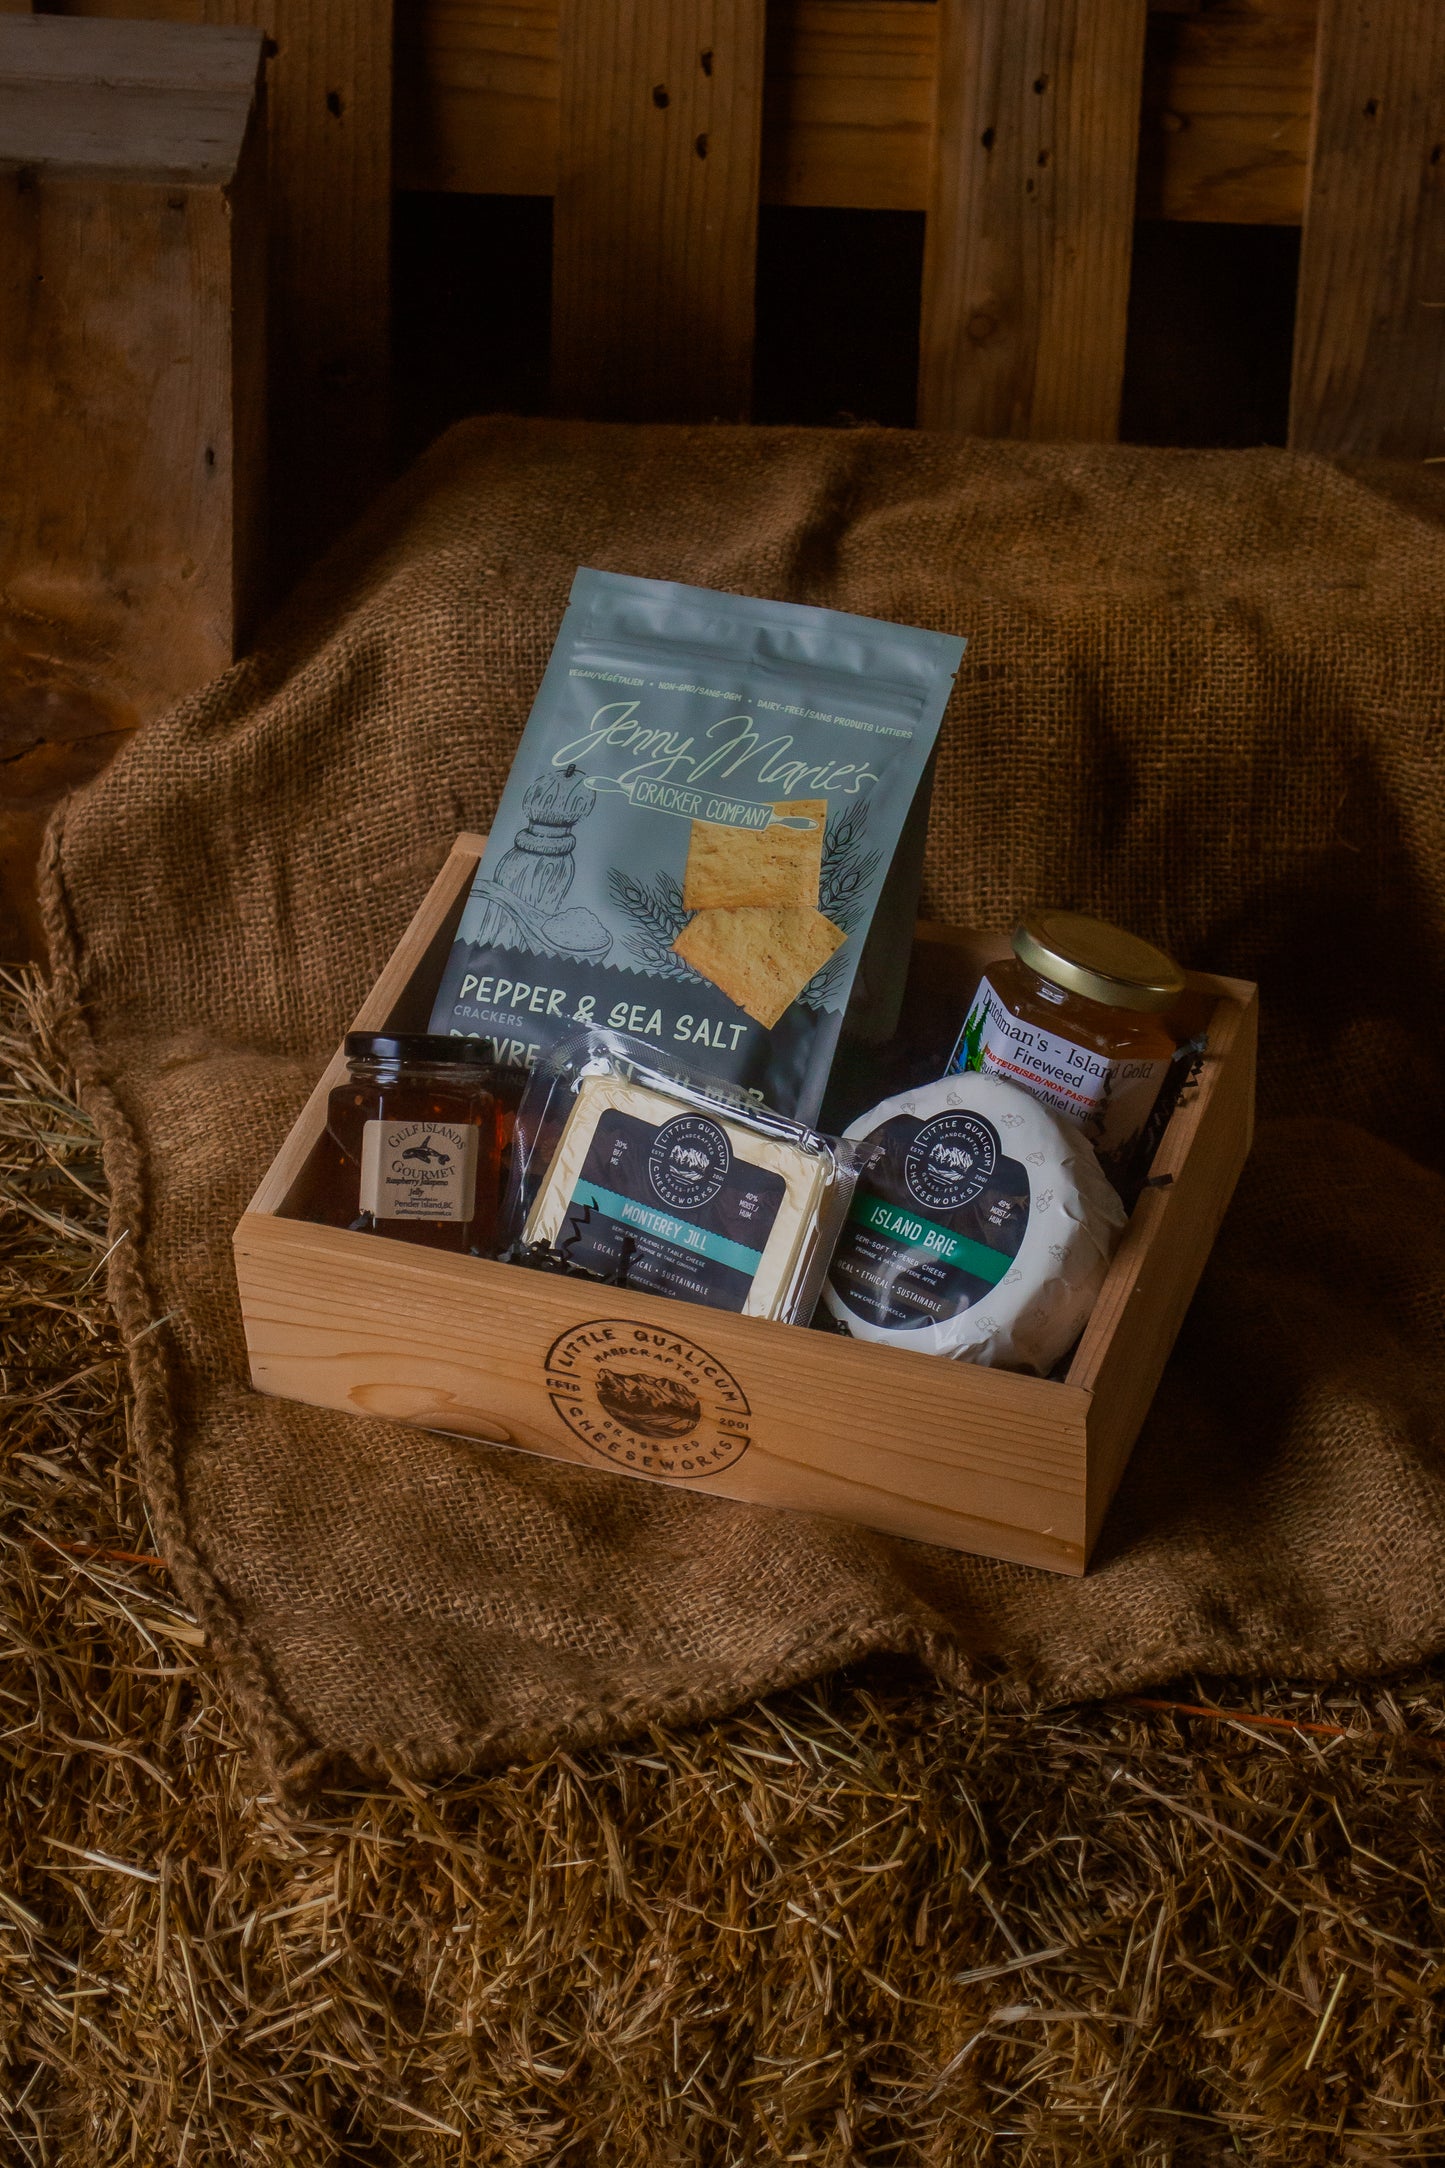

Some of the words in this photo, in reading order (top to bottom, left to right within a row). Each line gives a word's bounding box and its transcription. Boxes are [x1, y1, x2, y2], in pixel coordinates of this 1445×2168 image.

[757, 699, 832, 723] DAIRY-FREE/SANS
[833, 716, 874, 732] PRODUITS
[875, 725, 913, 739] LAITIERS
[552, 700, 695, 784] Jenny
[687, 715, 879, 796] Marie's
[635, 782, 703, 816] CRACKER
[705, 799, 771, 827] COMPANY
[453, 1004, 523, 1028] CRACKERS
[459, 974, 567, 1018] PEPPER
[572, 995, 597, 1023] &
[607, 1002, 662, 1037] SEA
[673, 1014, 748, 1051] SALT
[982, 990, 1049, 1053] Dutchman's
[1066, 1047, 1118, 1080] Island
[1123, 1062, 1153, 1079] Gold
[1013, 1046, 1084, 1088] Fireweed
[388, 1124, 419, 1149] GULF
[421, 1122, 466, 1150] ISLANDS
[661, 1122, 692, 1143] LITTLE
[698, 1123, 727, 1166] QUALICUM
[923, 1120, 957, 1141] LITTLE
[965, 1122, 991, 1167] QUALICUM
[391, 1160, 456, 1180] GOURMET
[652, 1165, 714, 1204] CHEESEWORKS
[909, 1164, 974, 1205] CHEESEWORKS
[394, 1200, 419, 1208] Pender
[621, 1203, 683, 1239] MONTEREY
[683, 1229, 707, 1251] JILL
[870, 1206, 922, 1241] ISLAND
[923, 1229, 958, 1257] BRIE
[593, 1241, 614, 1257] LOCAL
[661, 1270, 709, 1295] SUSTAINABLE
[640, 1236, 665, 1250] FRIENDLY
[667, 1247, 683, 1258] TABLE
[685, 1255, 706, 1268] CHEESE
[855, 1234, 890, 1253] SEMI-SOFT
[892, 1249, 919, 1267] RIPENED
[921, 1264, 947, 1279] CHEESE
[837, 1260, 854, 1273] OCAL
[861, 1270, 889, 1289] ETHICAL
[896, 1286, 942, 1312] SUSTAINABLE
[558, 1329, 616, 1367] LITTLE
[633, 1330, 738, 1402] QUALICUM
[593, 1347, 700, 1385] HANDCRAFTED
[569, 1406, 733, 1472] CHEESEWORKS
[603, 1420, 701, 1453] GRASS-FED
[719, 1417, 750, 1431] 2001
